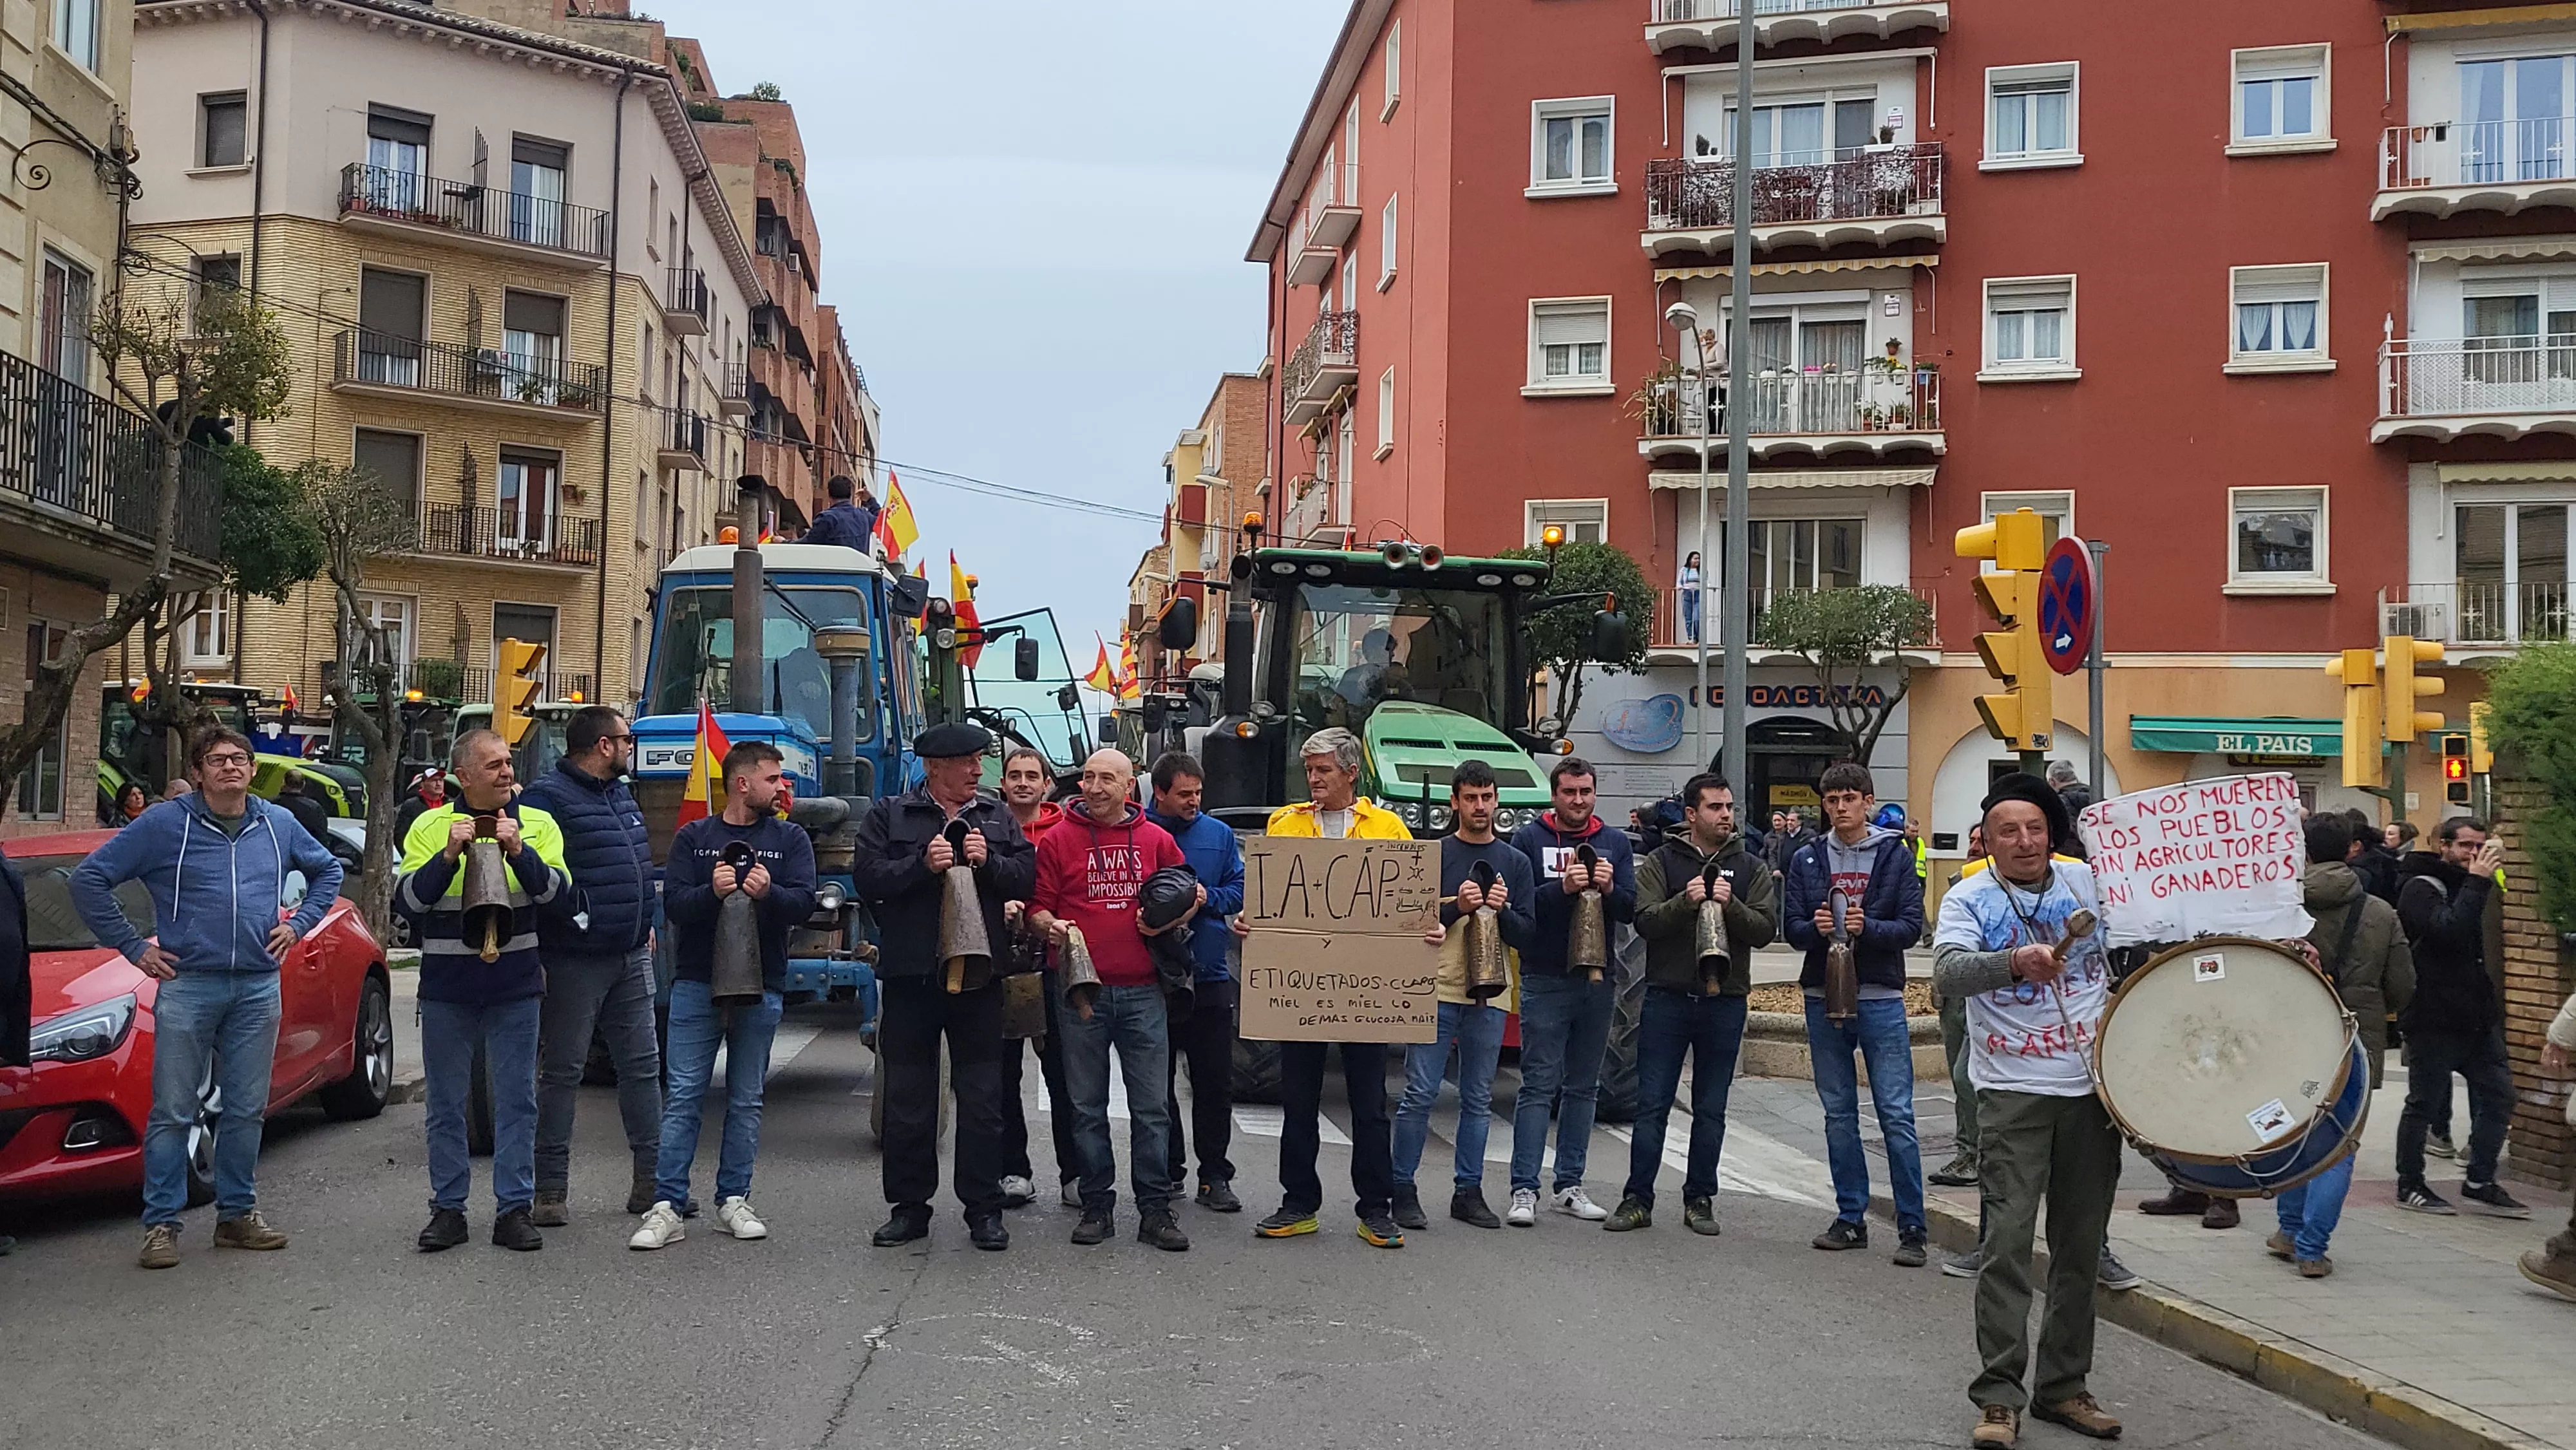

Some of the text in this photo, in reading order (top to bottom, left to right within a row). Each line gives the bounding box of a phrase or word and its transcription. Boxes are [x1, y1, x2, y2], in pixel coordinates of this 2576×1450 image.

[2215, 734, 2313, 753] EL PAIS
[646, 749, 695, 766] FO
[2087, 776, 2295, 827] SE NOS MUEREN
[2098, 805, 2286, 850] LOS PUEBLOS
[694, 849, 720, 857] TOMM
[1087, 849, 1142, 870] AWAS
[1119, 871, 1128, 881] IN
[2151, 854, 2296, 899] GANADEROS
[1249, 968, 1382, 991] ETIQUETADOS
[1316, 999, 1334, 1008] ES
[1392, 999, 1411, 1009] LO
[1299, 1014, 1348, 1026] DEMAS
[1354, 1013, 1406, 1024] GLUCOSA
